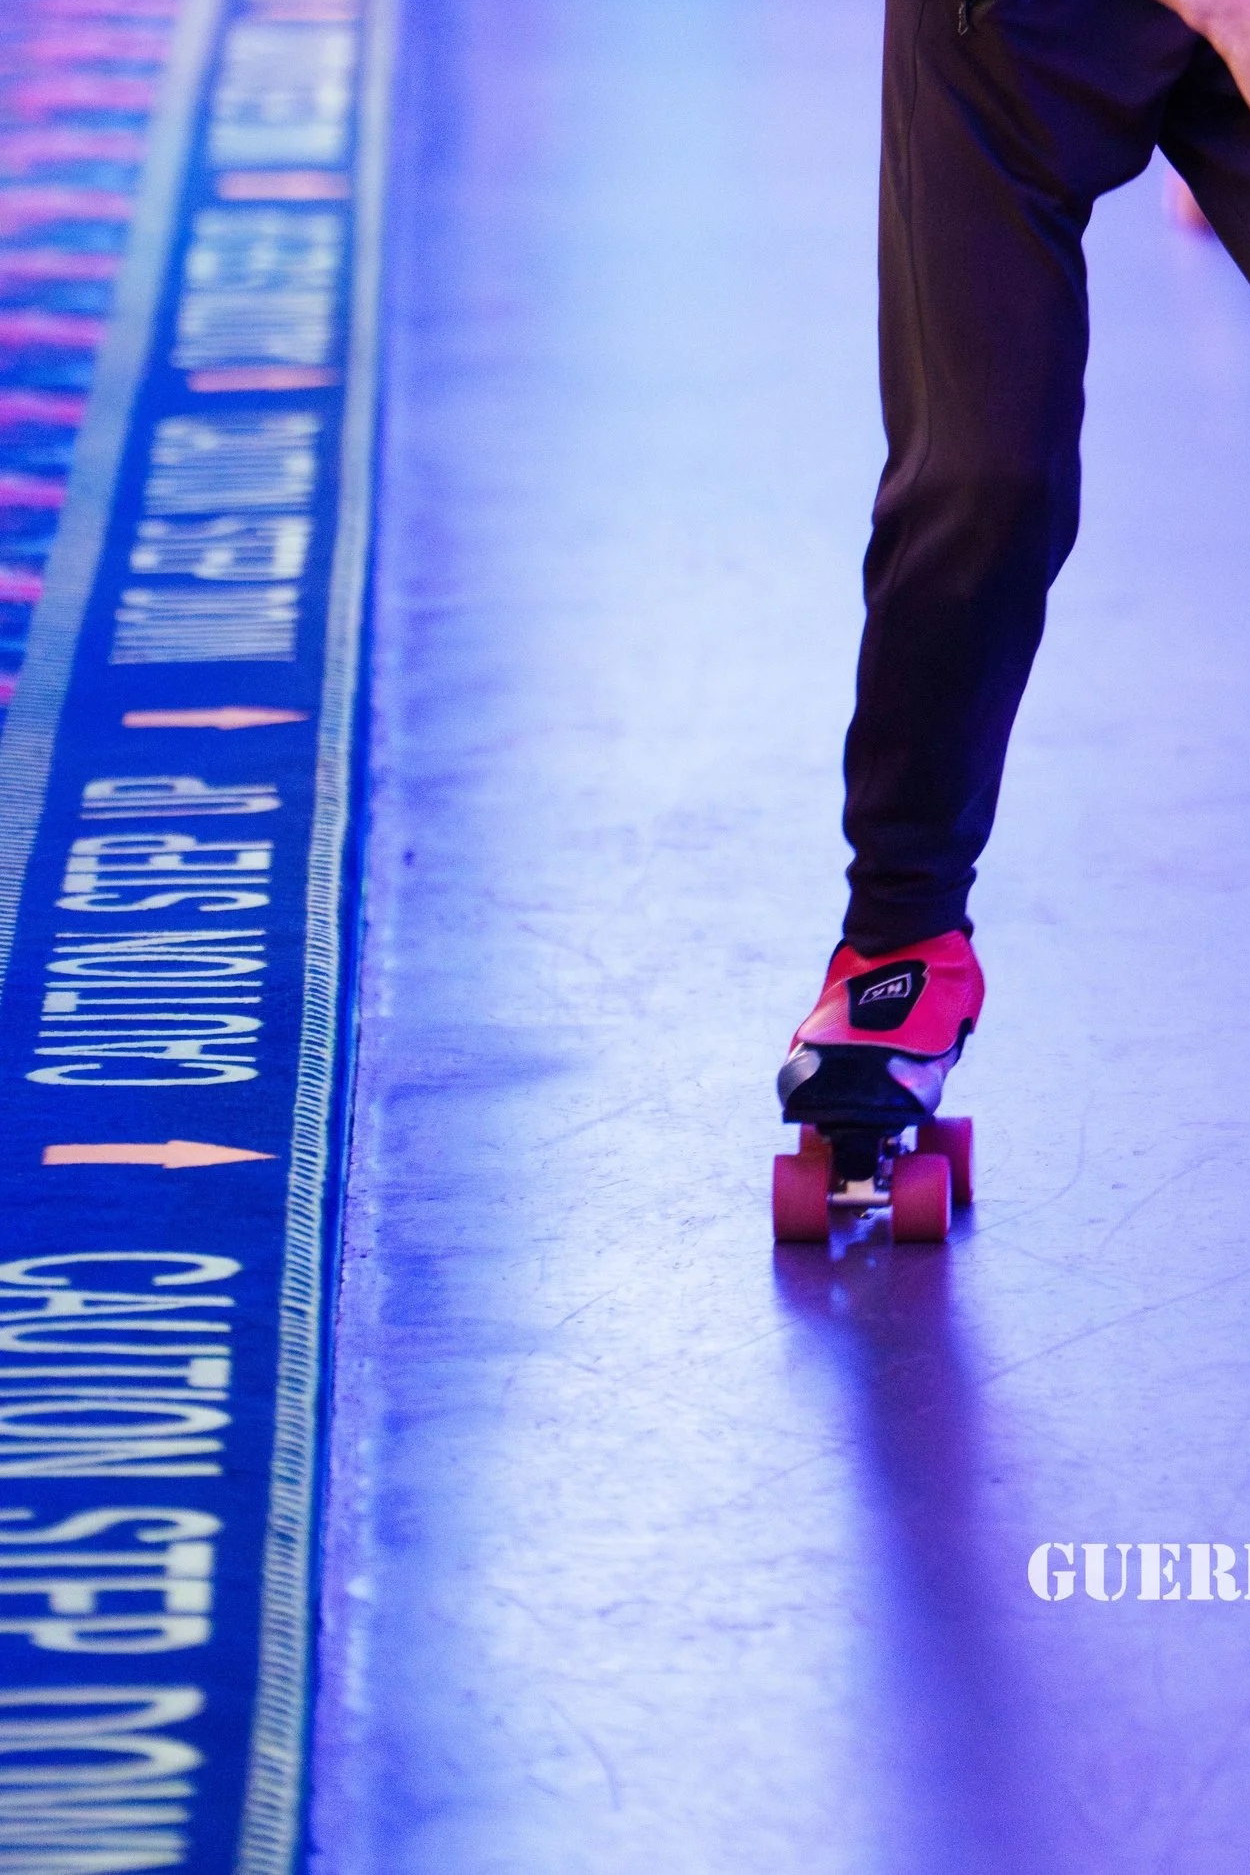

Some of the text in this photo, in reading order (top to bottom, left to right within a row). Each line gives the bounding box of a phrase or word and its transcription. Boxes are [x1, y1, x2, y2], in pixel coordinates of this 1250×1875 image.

[25, 776, 282, 1085] CAUTION STEP UP
[0, 1251, 243, 1477] CAUTION
[0, 1506, 224, 1654] STEP
